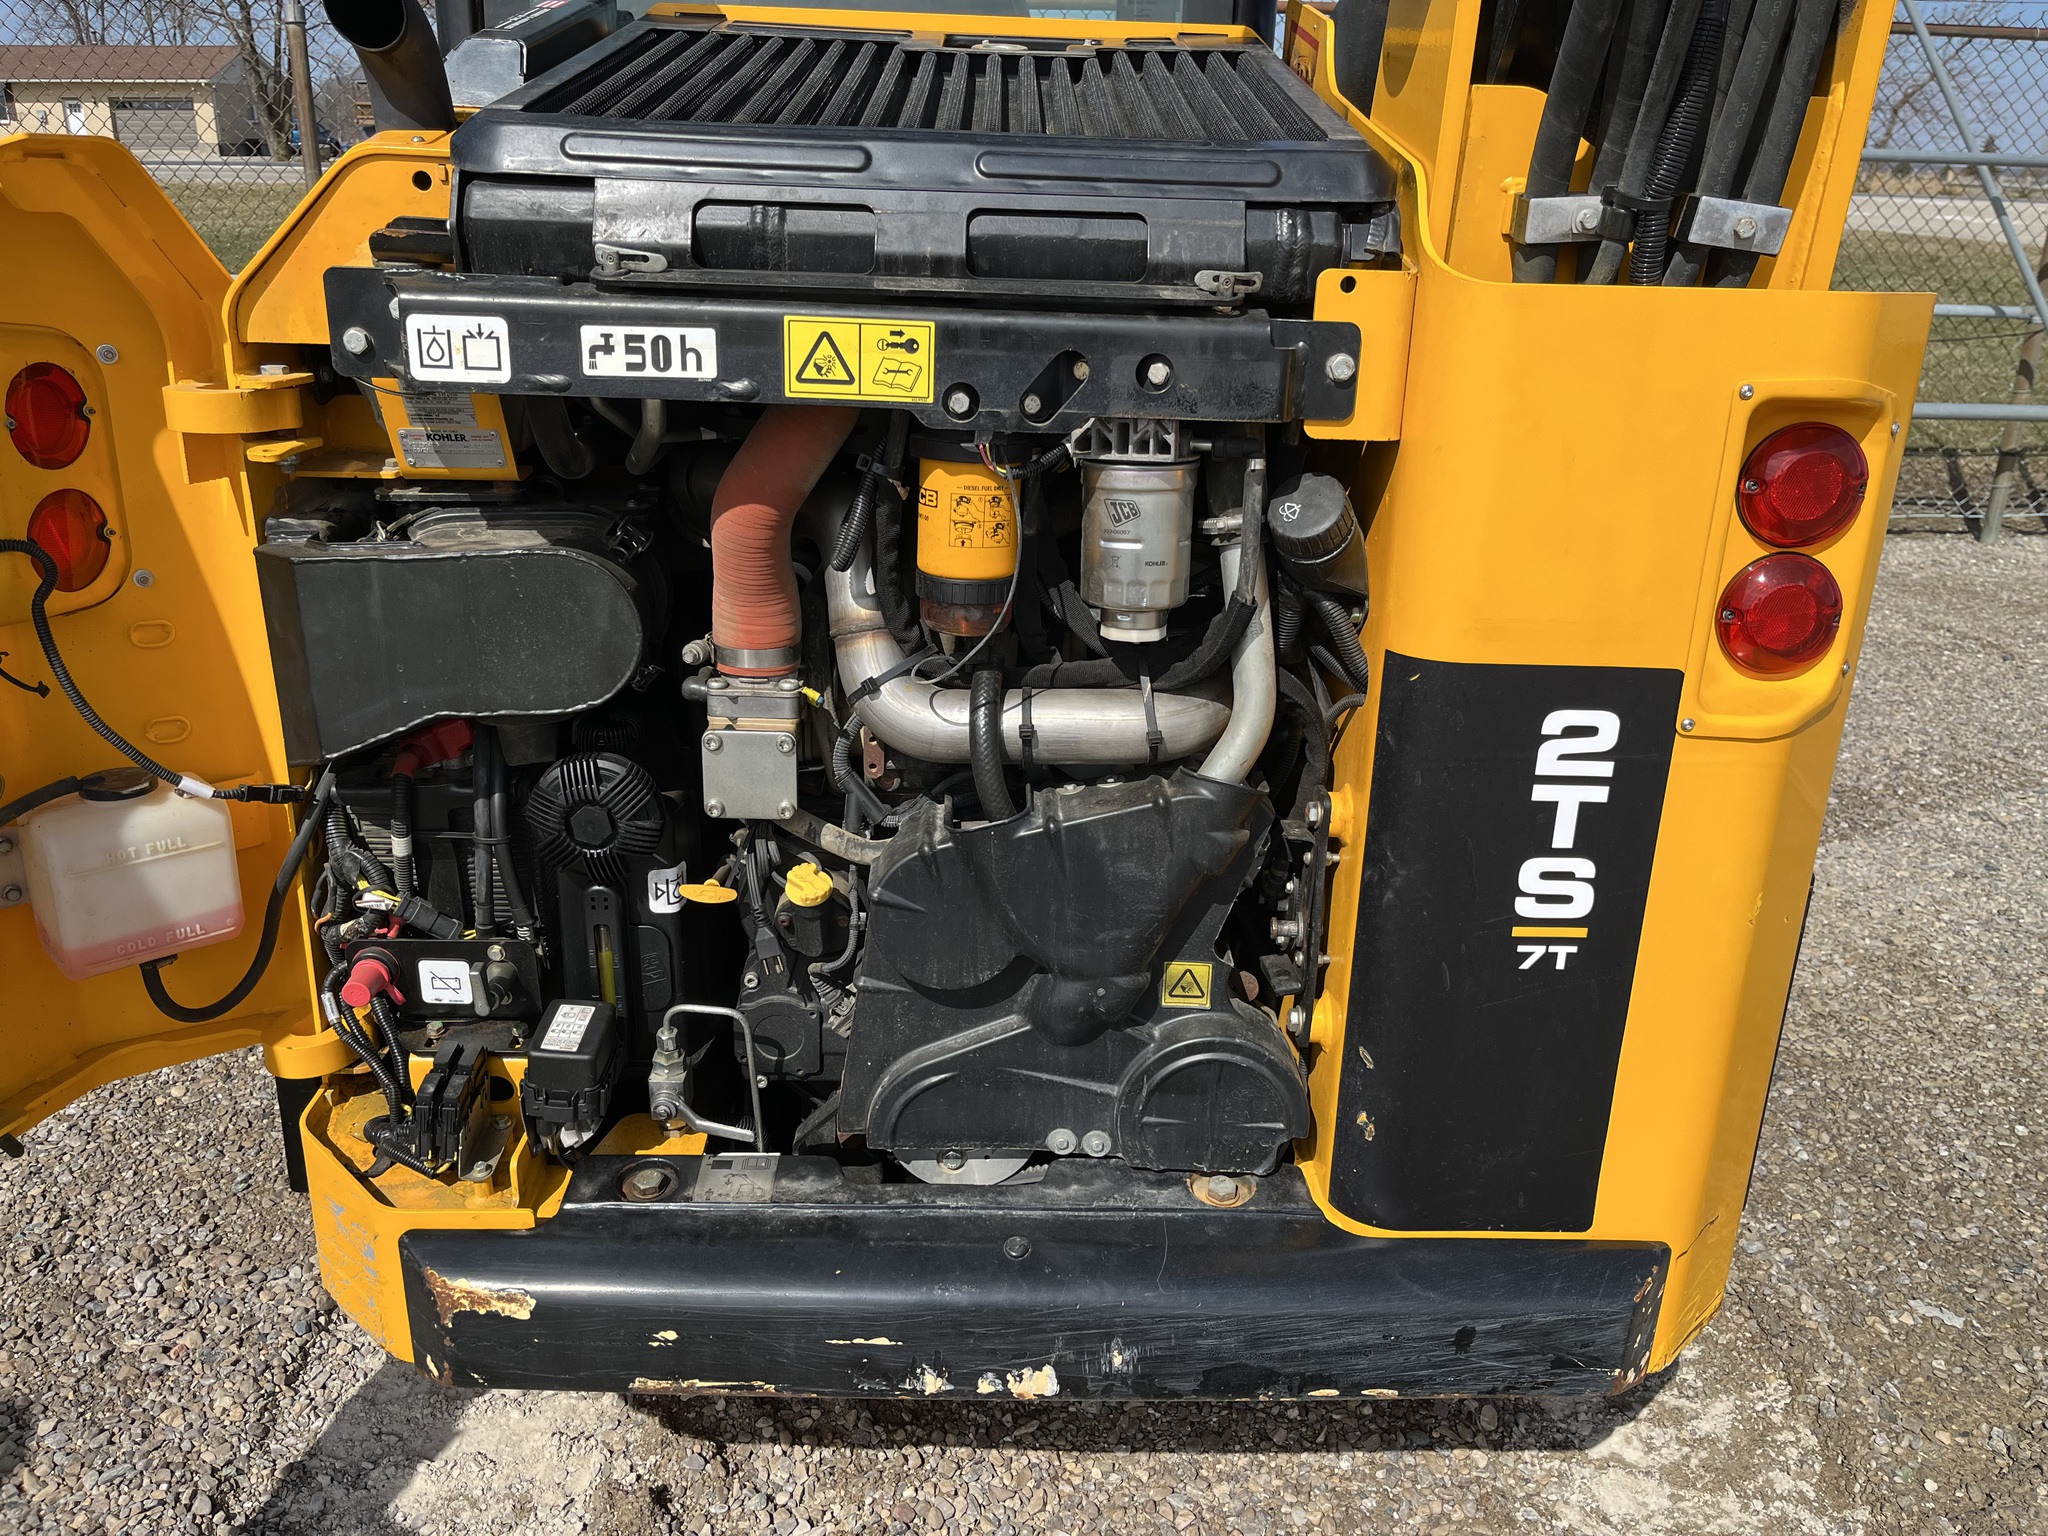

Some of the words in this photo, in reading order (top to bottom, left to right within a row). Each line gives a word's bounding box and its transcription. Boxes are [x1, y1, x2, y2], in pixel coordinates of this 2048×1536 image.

[425, 433, 468, 442] KOHLER
[918, 487, 938, 507] CB
[1108, 500, 1139, 525] JCB
[1514, 709, 1621, 919] 2TS
[106, 847, 138, 864] HOT
[145, 836, 187, 855] FULL
[116, 935, 158, 956] COLD
[165, 923, 206, 943] FULL
[1516, 944, 1578, 970] 7T
